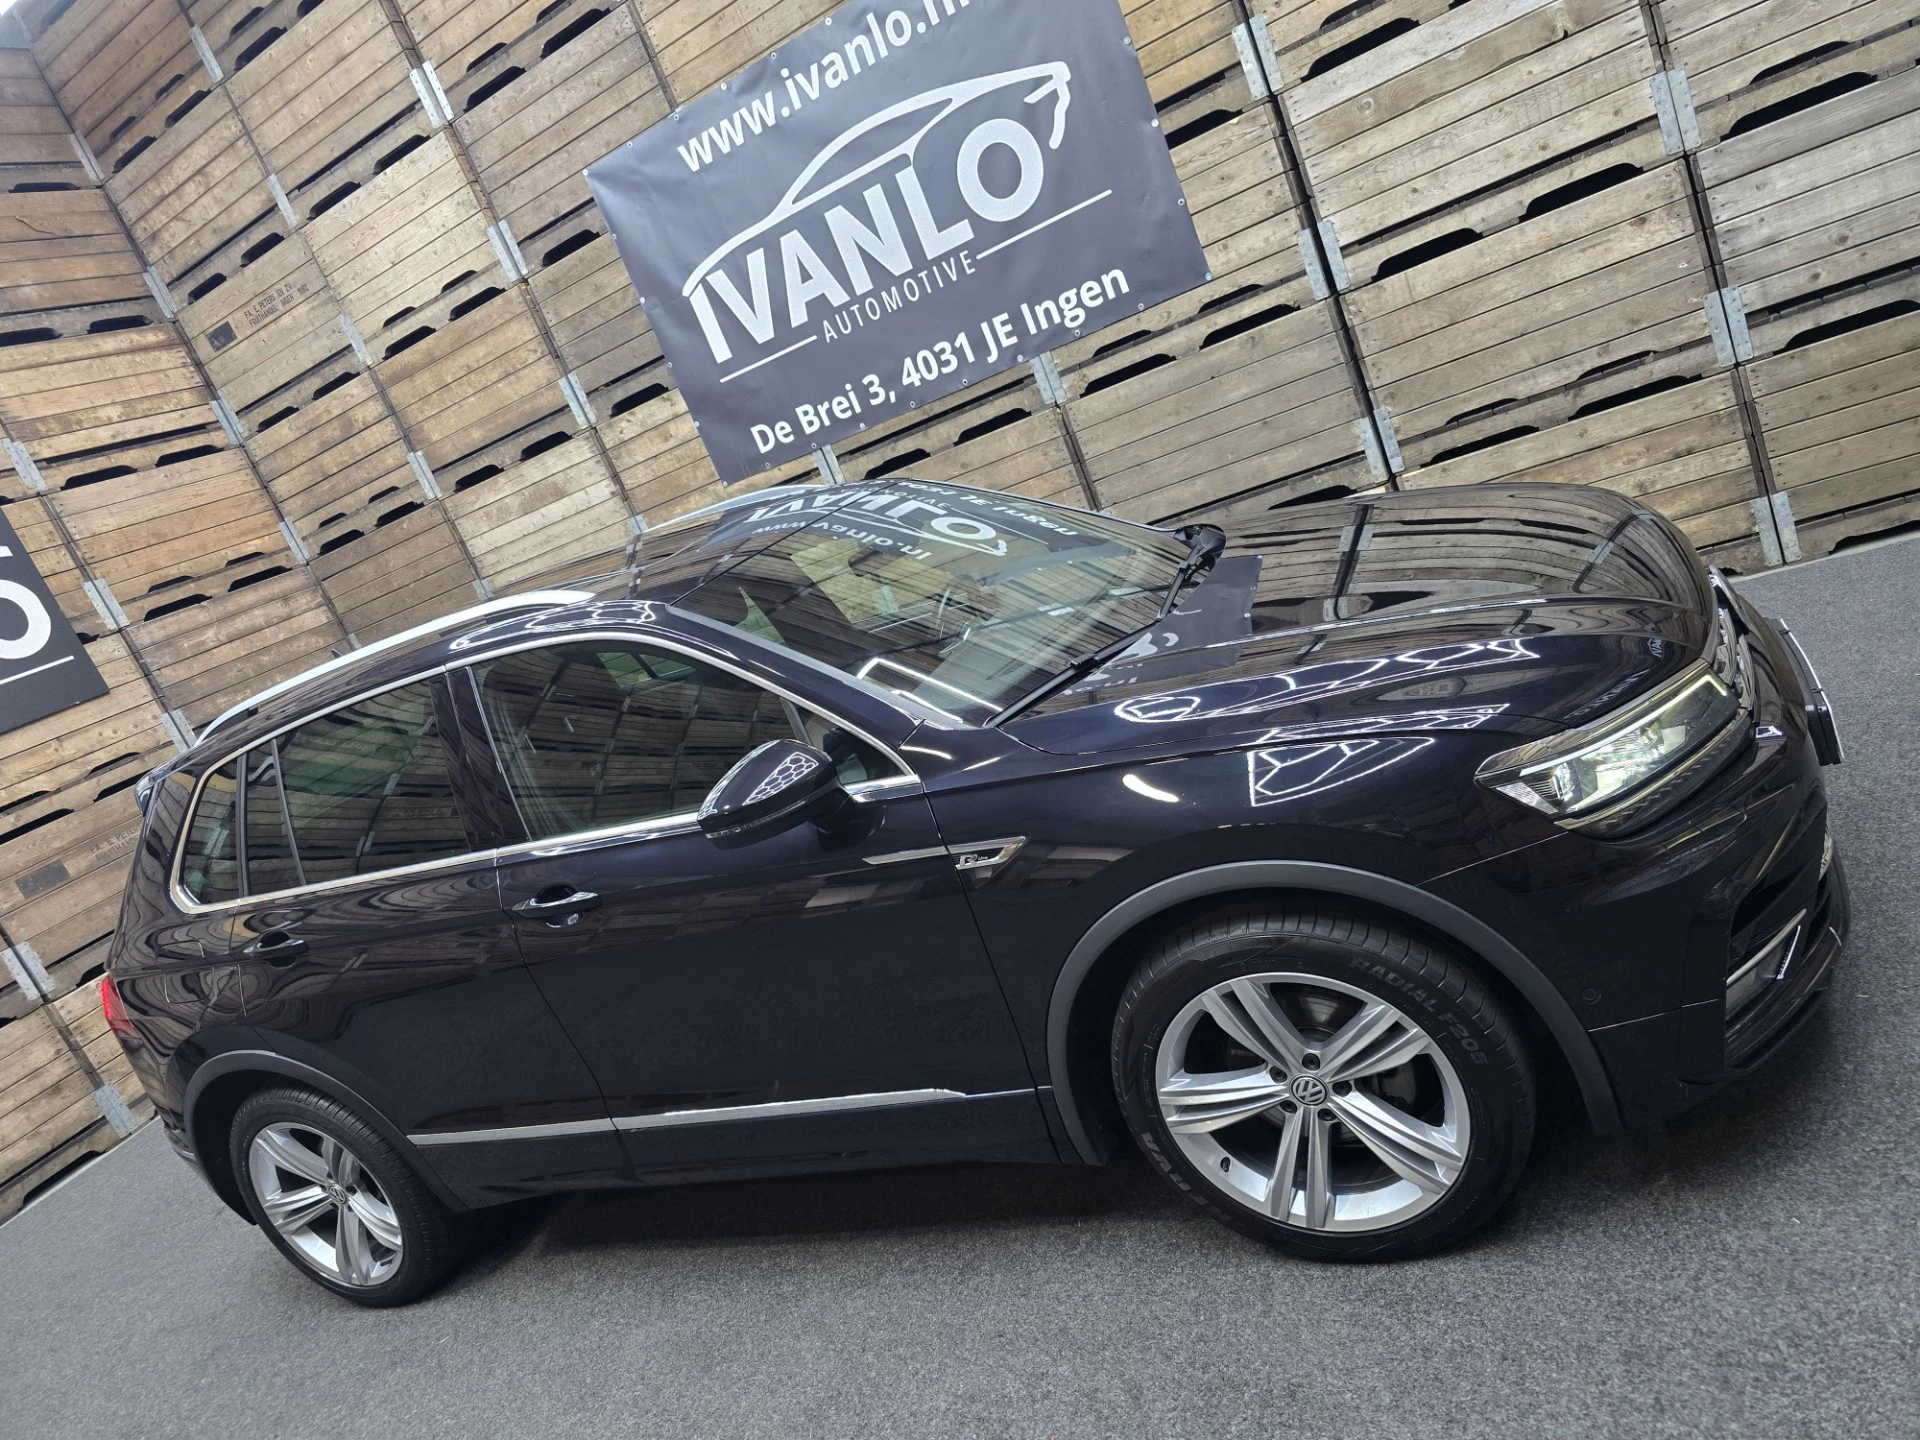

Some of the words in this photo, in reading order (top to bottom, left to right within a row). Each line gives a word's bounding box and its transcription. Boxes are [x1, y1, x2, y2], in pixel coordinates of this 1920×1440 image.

[689, 118, 1044, 364] IVANLO
[823, 249, 976, 343] AUTOMOTIVE
[750, 419, 795, 454] De
[795, 383, 862, 435] Brei
[861, 373, 897, 404] 3,
[902, 331, 976, 388] 4031
[980, 312, 1019, 364] JE
[1020, 267, 1131, 336] Ingen
[1349, 957, 1438, 1012] RADIAL
